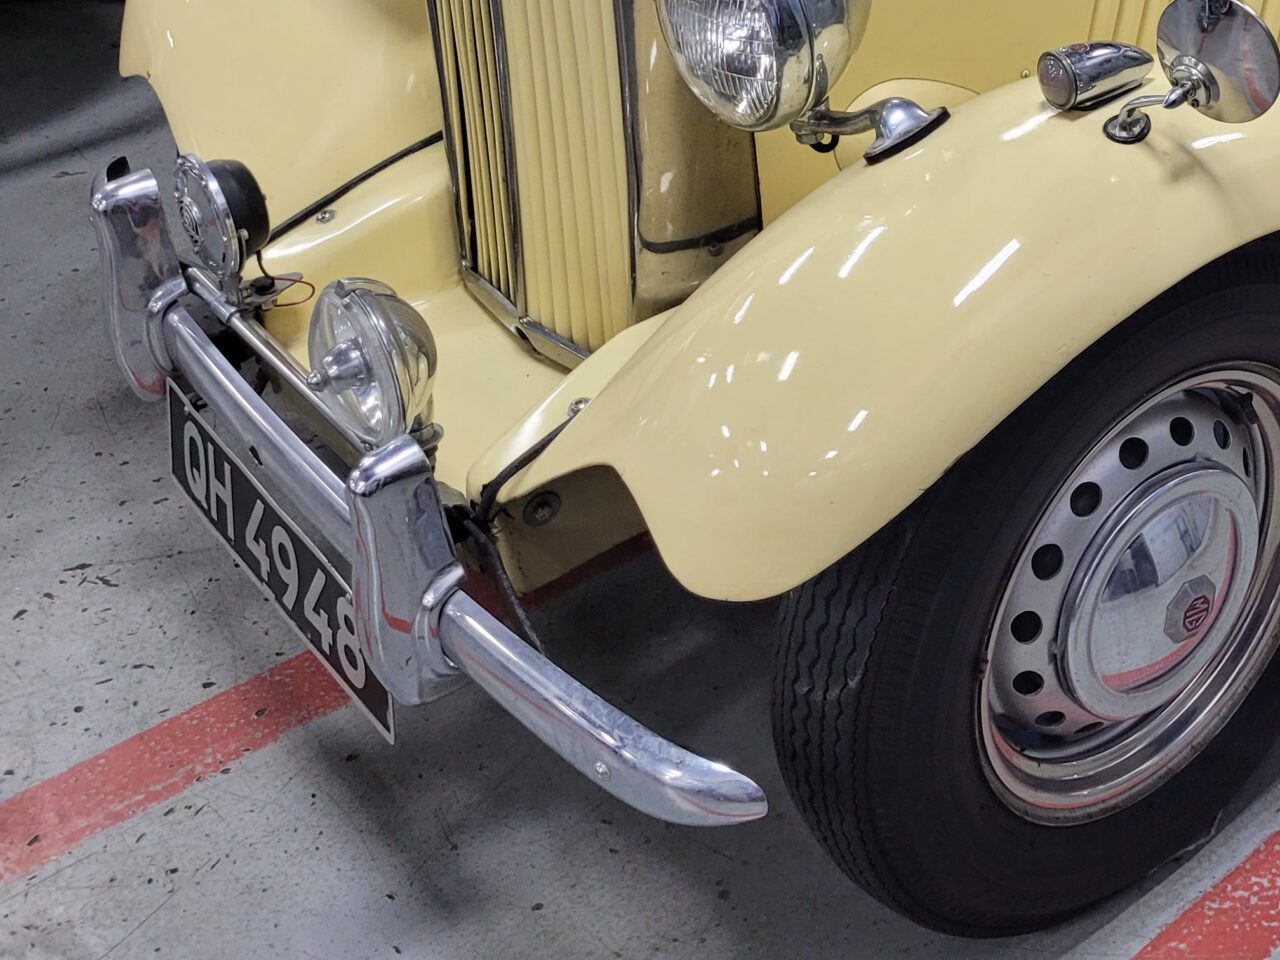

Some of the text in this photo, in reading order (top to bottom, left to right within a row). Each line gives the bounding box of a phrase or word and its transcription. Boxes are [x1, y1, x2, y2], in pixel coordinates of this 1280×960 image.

[183, 420, 367, 689] QH 4948
[1184, 598, 1208, 629] MG
